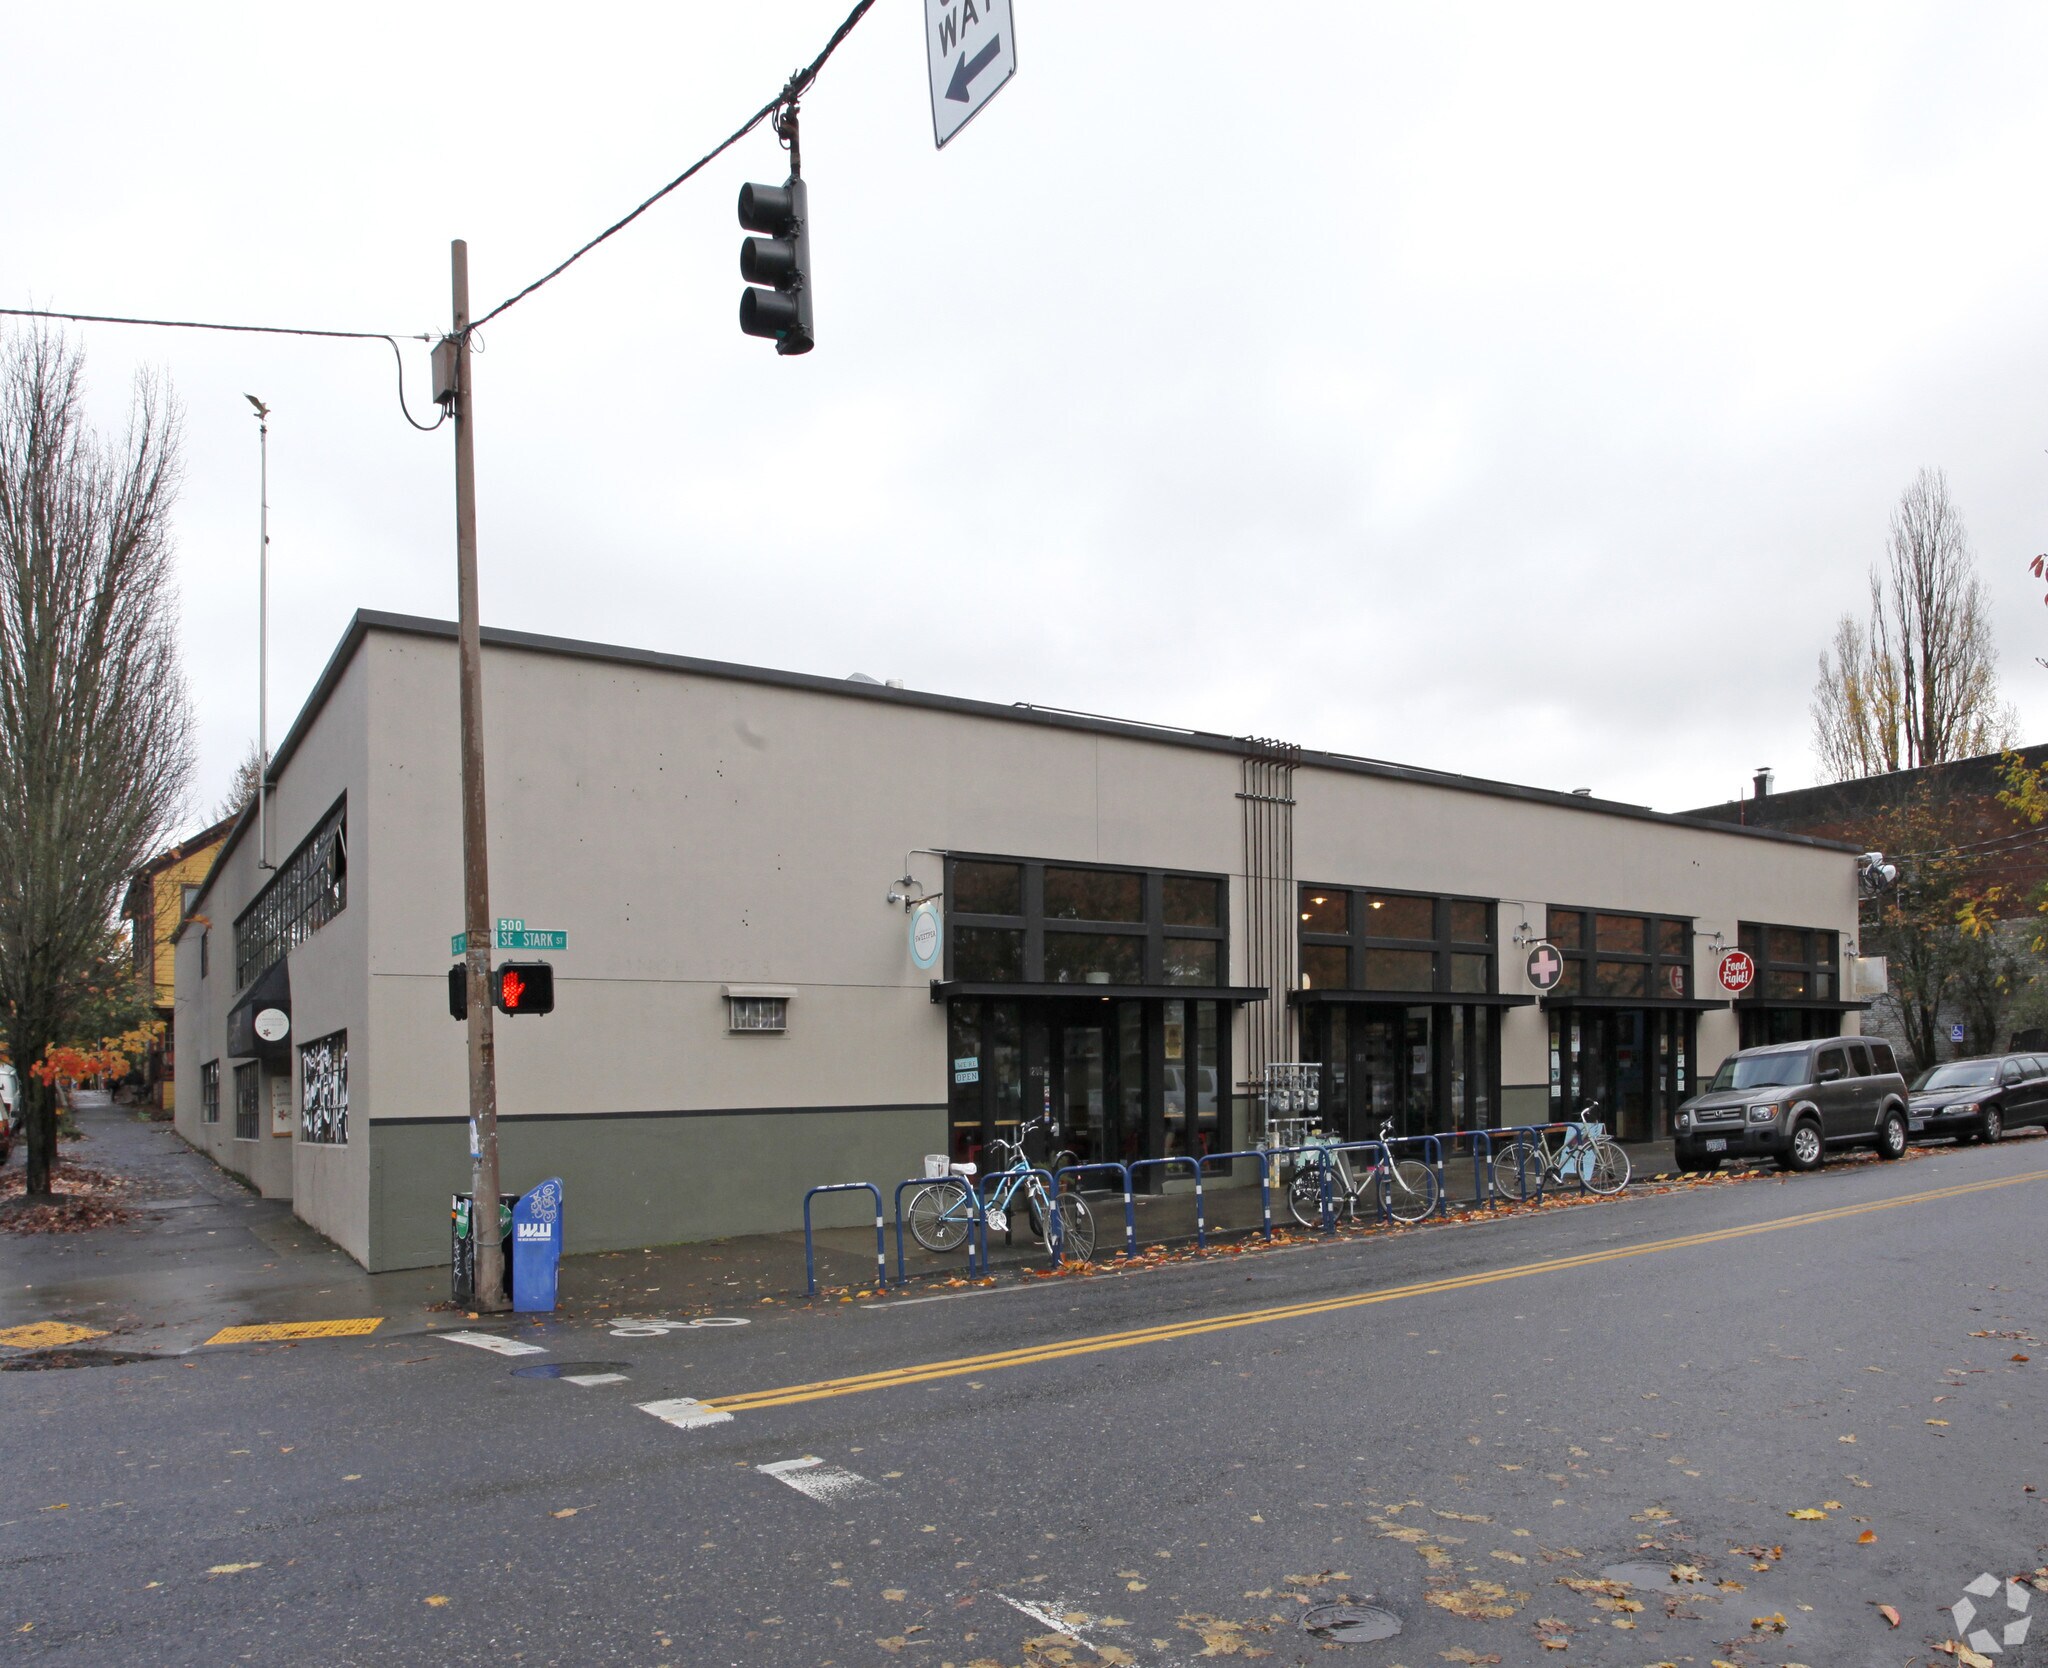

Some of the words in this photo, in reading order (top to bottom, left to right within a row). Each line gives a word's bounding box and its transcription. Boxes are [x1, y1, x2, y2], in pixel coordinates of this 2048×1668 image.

[501, 920, 522, 931] 500
[501, 932, 514, 946] SE
[523, 932, 553, 947] STARK
[555, 937, 563, 945] ST
[1725, 957, 1747, 972] Food
[1723, 970, 1749, 987] Fight!
[956, 1072, 977, 1082] OPEN
